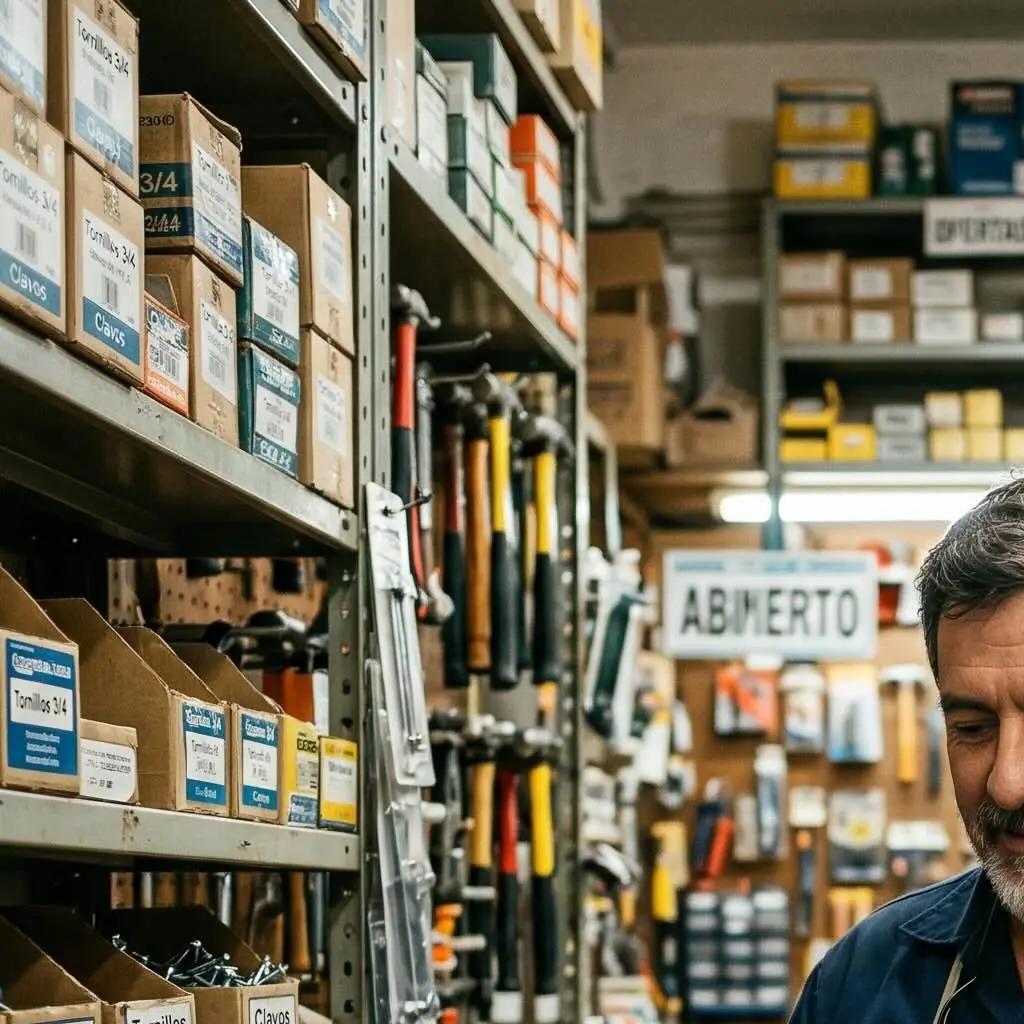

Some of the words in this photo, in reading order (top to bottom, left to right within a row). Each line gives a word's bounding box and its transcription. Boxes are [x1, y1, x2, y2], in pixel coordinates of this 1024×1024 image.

[140, 172, 179, 194] 3/4
[14, 689, 51, 714] Tornillos
[53, 696, 67, 717] 3/4
